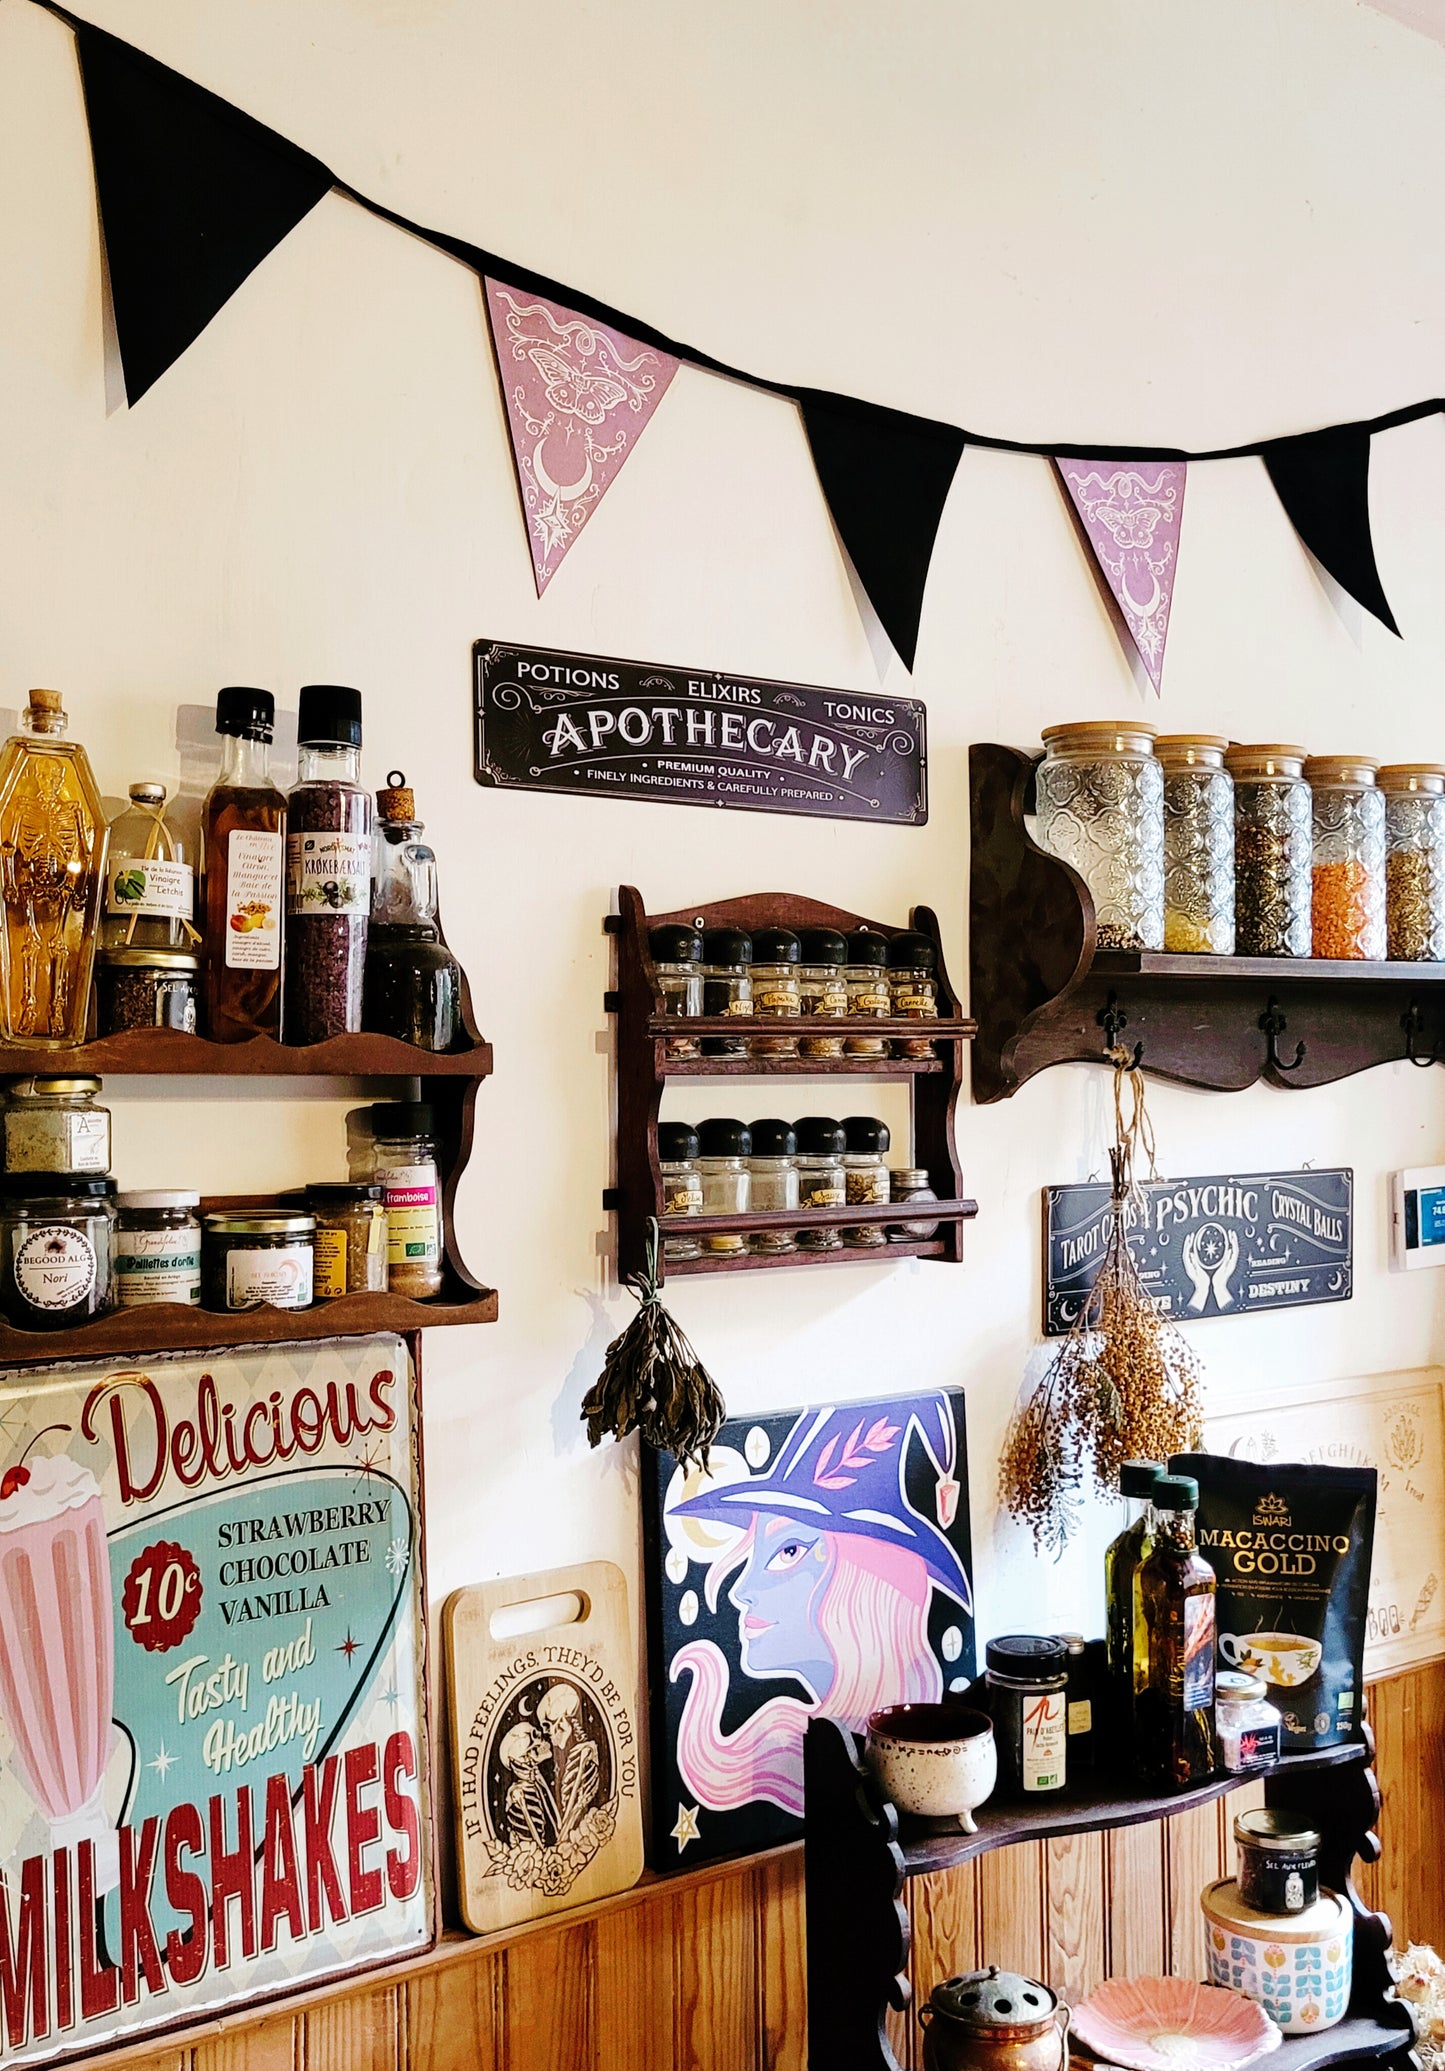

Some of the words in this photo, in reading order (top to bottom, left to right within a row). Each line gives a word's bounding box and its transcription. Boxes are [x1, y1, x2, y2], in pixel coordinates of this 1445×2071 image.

[516, 661, 620, 691] POTIONS
[687, 680, 762, 704] ELIXIRS
[823, 701, 896, 725] TONICS
[542, 706, 870, 784] APOTHECARY
[657, 759, 715, 775] PREMIUM
[717, 766, 771, 780] QUALITY
[587, 769, 627, 783] FINELY
[629, 772, 705, 791] INGREDIENTS
[706, 780, 715, 791] &
[717, 781, 779, 797] CAREFULLY
[780, 788, 834, 802] PREPARED
[238, 852, 274, 863] Vinaigre
[150, 874, 181, 886] Vinaigre
[156, 886, 184, 897] Letchis
[386, 1191, 429, 1204] framboise
[1156, 1185, 1259, 1232] PSYCHIC
[1271, 1189, 1312, 1230] CRYSTAL
[1313, 1207, 1342, 1242] BALLS
[24, 1256, 66, 1265] BEGOOD
[1060, 1224, 1101, 1270] TAROT
[126, 1256, 170, 1269] Paillettes
[1250, 1257, 1287, 1268] READING
[42, 1273, 68, 1284] Nori
[1248, 1278, 1311, 1299] DESTINY
[82, 1370, 398, 1506] Delicious
[217, 1499, 391, 1549] STRAWBERRY
[1252, 1514, 1292, 1527] ISWARI
[1199, 1529, 1350, 1555] MACACCINO
[218, 1539, 371, 1588] CHOCOLATE
[1233, 1550, 1317, 1576] GOLD
[218, 1584, 331, 1627] VANILLA
[164, 1652, 249, 1724] Tasty
[261, 1617, 317, 1683] and
[543, 1646, 605, 1685] THEY'D
[599, 1679, 622, 1708] BE
[202, 1695, 325, 1776] Healthy
[612, 1706, 635, 1749] FOR
[463, 1746, 480, 1799] HAD
[620, 1754, 636, 1798] YOU
[463, 1801, 478, 1812] I
[466, 1817, 483, 1840] IF
[0, 1730, 423, 2052] MILKSHAKES
